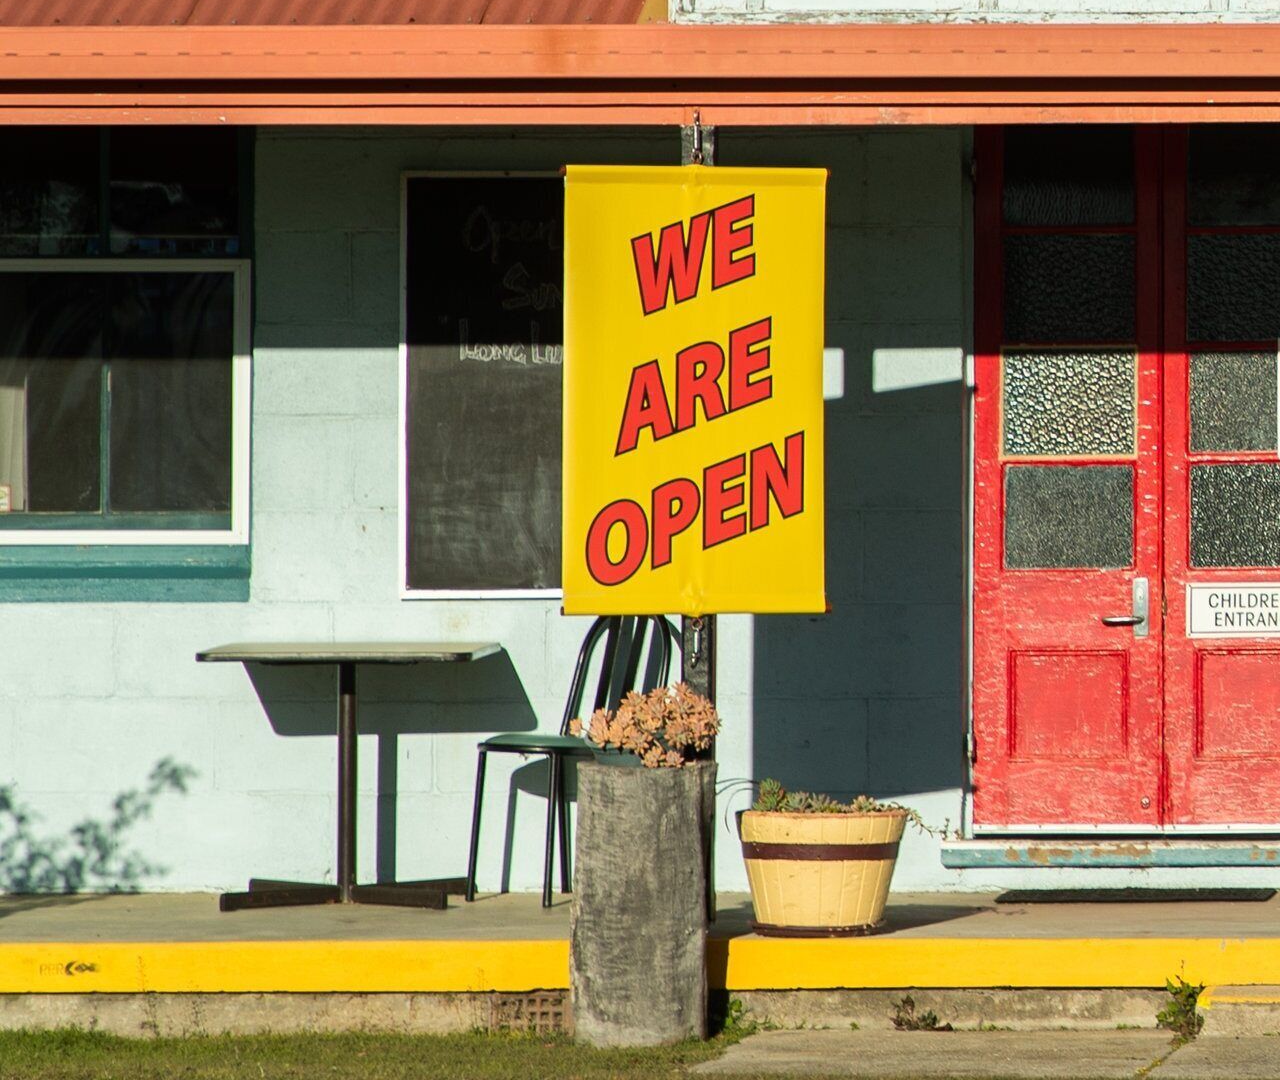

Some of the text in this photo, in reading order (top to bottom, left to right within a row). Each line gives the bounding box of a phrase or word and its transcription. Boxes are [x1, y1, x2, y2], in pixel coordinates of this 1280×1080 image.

[631, 193, 756, 317] WE
[614, 316, 773, 457] ARE
[585, 430, 805, 586] OPEN
